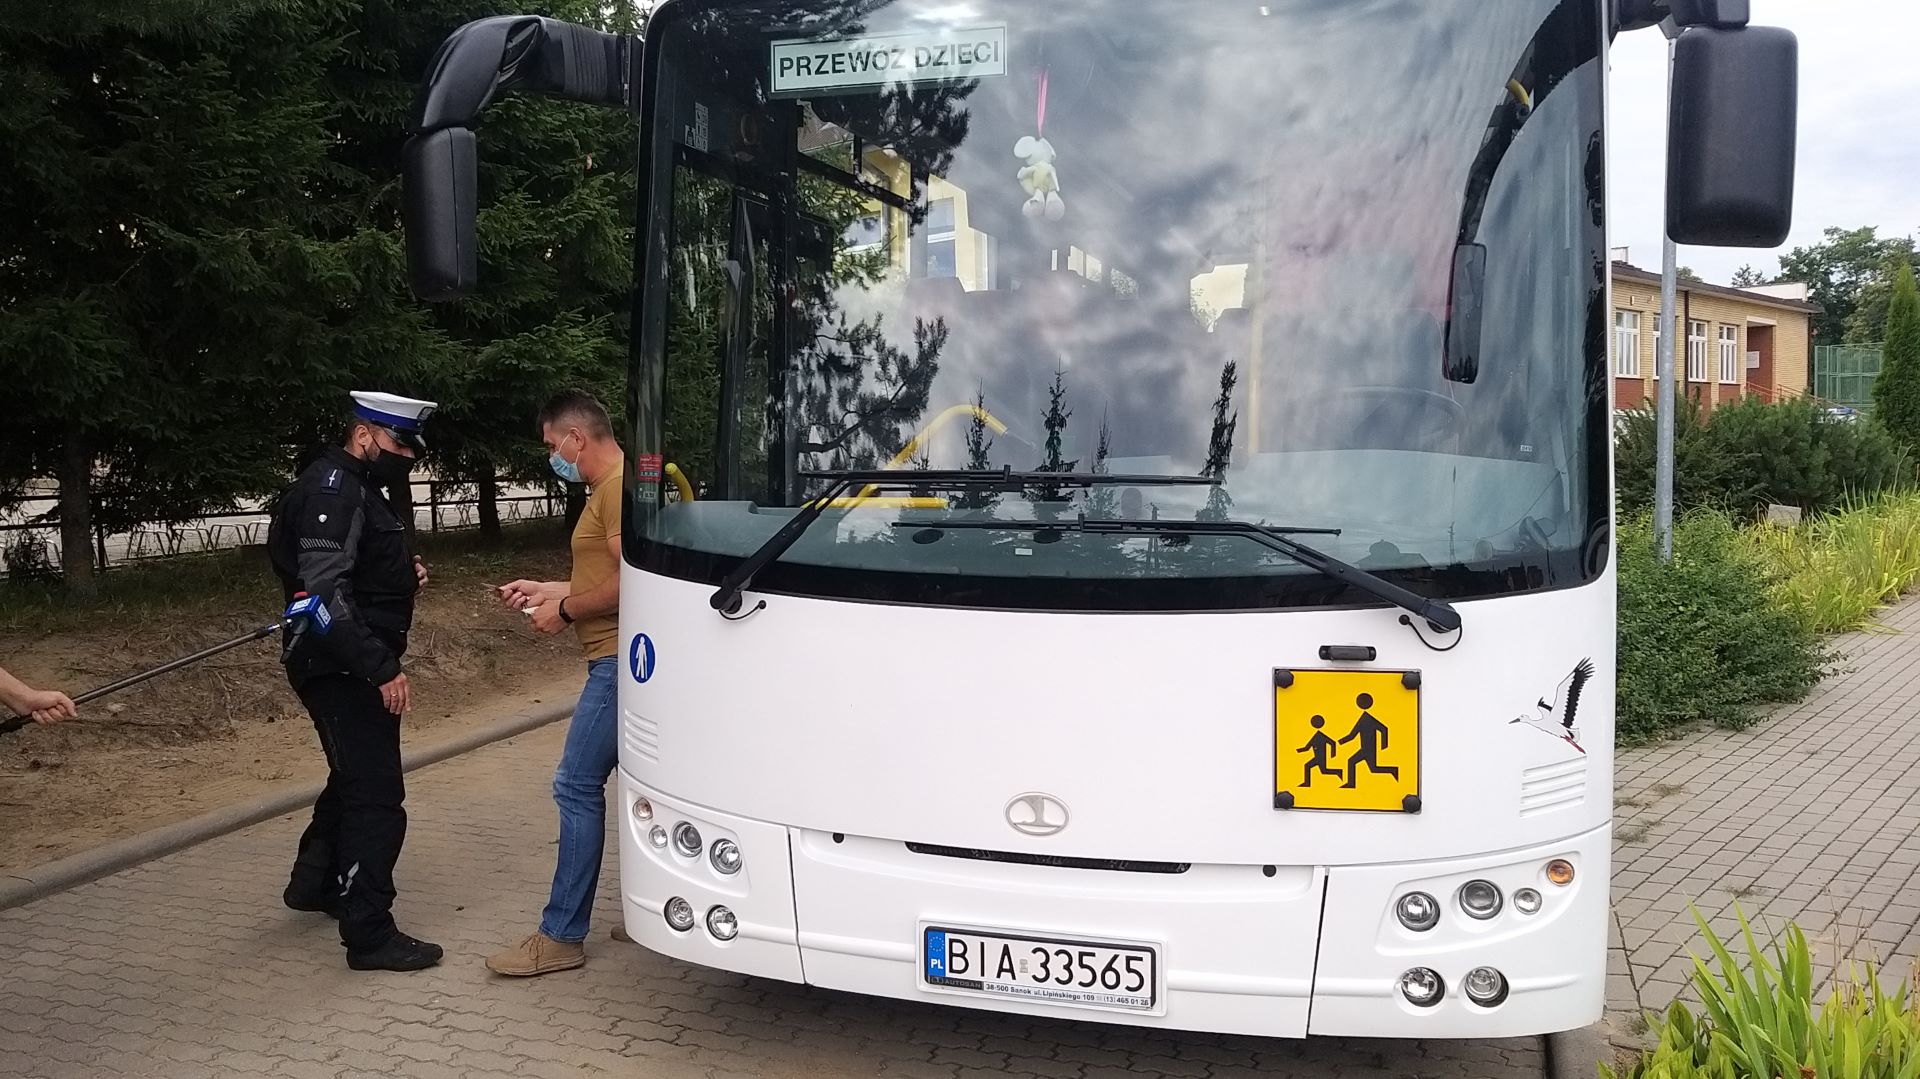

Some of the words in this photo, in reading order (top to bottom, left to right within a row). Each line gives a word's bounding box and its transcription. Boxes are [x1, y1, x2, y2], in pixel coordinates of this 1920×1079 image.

[779, 45, 907, 78] PRZEWÓZ
[914, 40, 999, 68] DZIECI
[930, 958, 944, 970] PL
[948, 937, 1017, 981] BIA
[1031, 947, 1145, 992] 33565
[945, 979, 981, 988] AUTOSAN
[1010, 987, 1032, 995] Sanok
